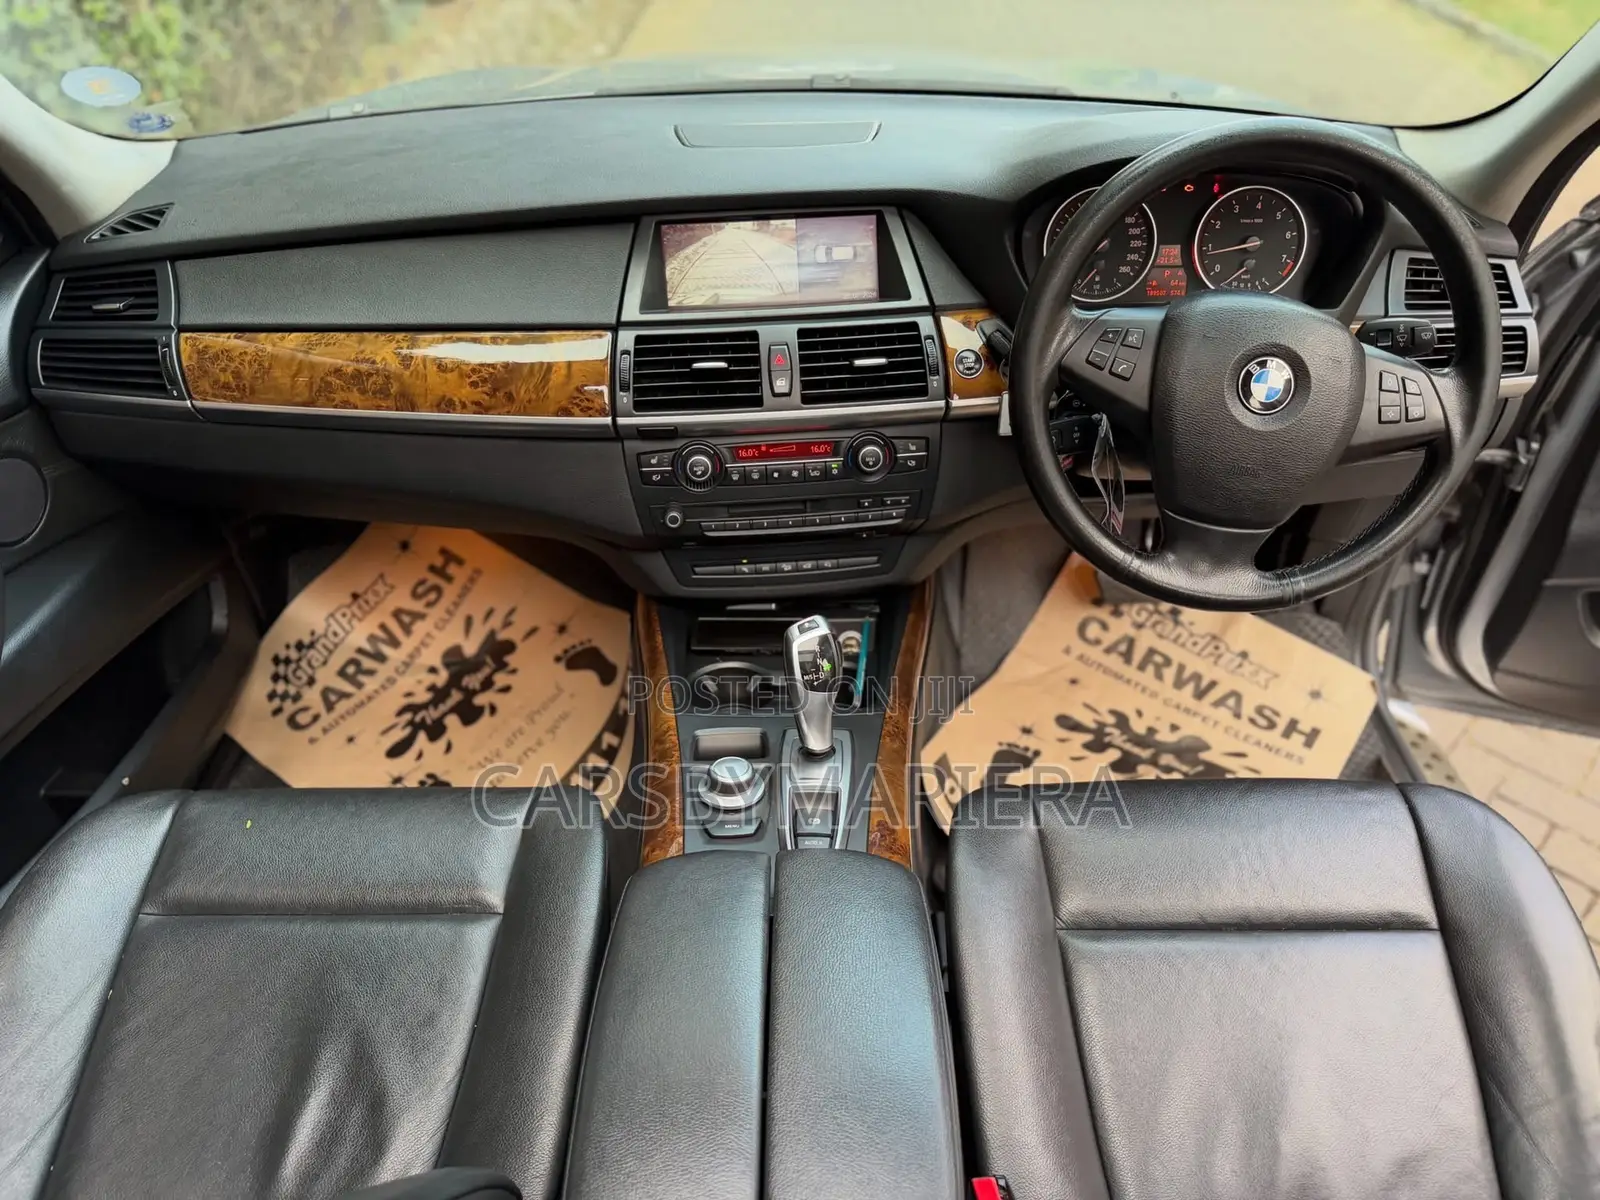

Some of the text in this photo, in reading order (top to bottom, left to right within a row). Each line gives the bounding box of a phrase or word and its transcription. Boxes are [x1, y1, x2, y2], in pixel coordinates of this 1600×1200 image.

[1233, 205, 1239, 213] 3
[1215, 221, 1221, 229] 2
[1285, 231, 1291, 239] 6
[1214, 264, 1220, 272] 0
[1248, 359, 1290, 381] BMW
[286, 547, 466, 731] CARWASH
[320, 676, 398, 736] AUTOMATED
[394, 631, 436, 677] CARPET
[433, 567, 484, 632] CLEANERS
[1076, 615, 1322, 750] CARWASH
[1075, 652, 1160, 699] AUTOMATED
[1162, 697, 1220, 729] CARPET
[1224, 725, 1305, 765] CLEANERS
